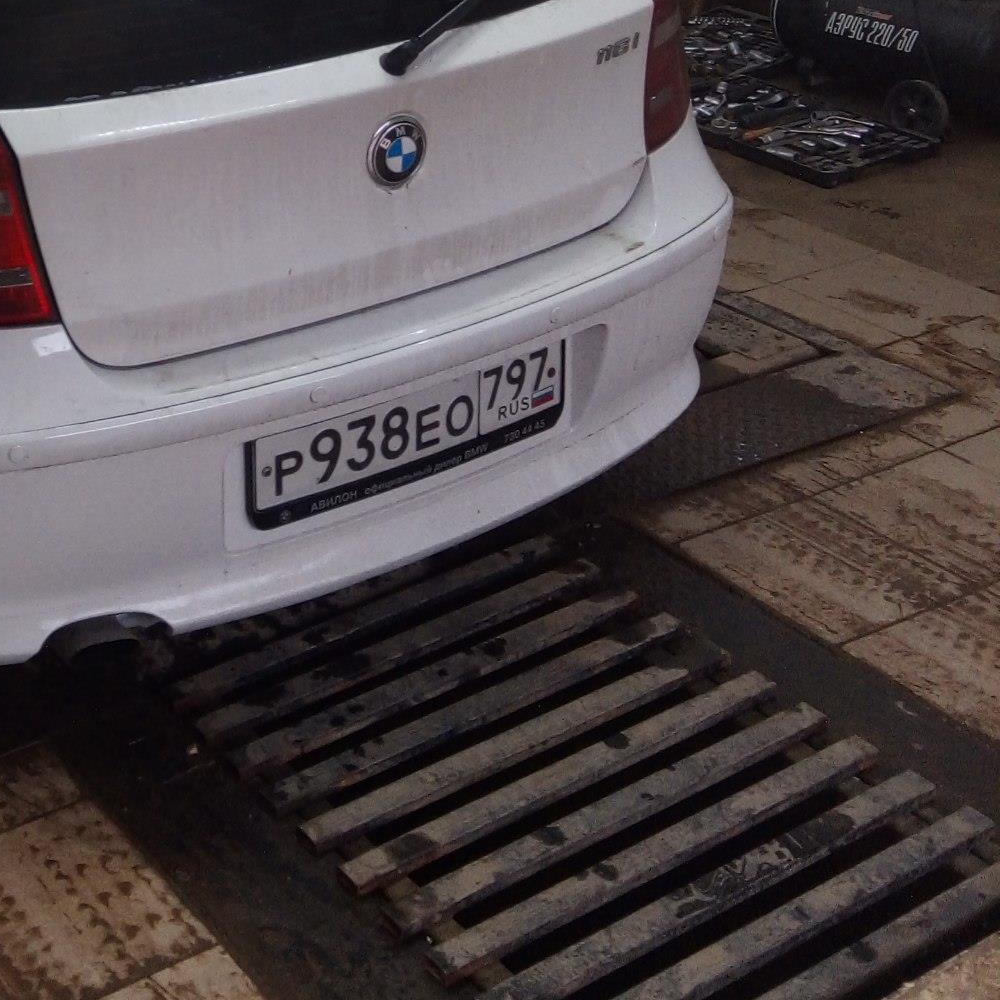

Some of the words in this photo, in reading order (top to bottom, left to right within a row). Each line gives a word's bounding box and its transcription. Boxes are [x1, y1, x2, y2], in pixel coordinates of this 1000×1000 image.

[824, 11, 871, 41] АЭРУС
[866, 21, 920, 53] 220/50
[275, 395, 474, 497] Р938ЕО
[483, 347, 549, 411] 797
[497, 396, 531, 421] RUS
[309, 490, 358, 514] АВИЛОН
